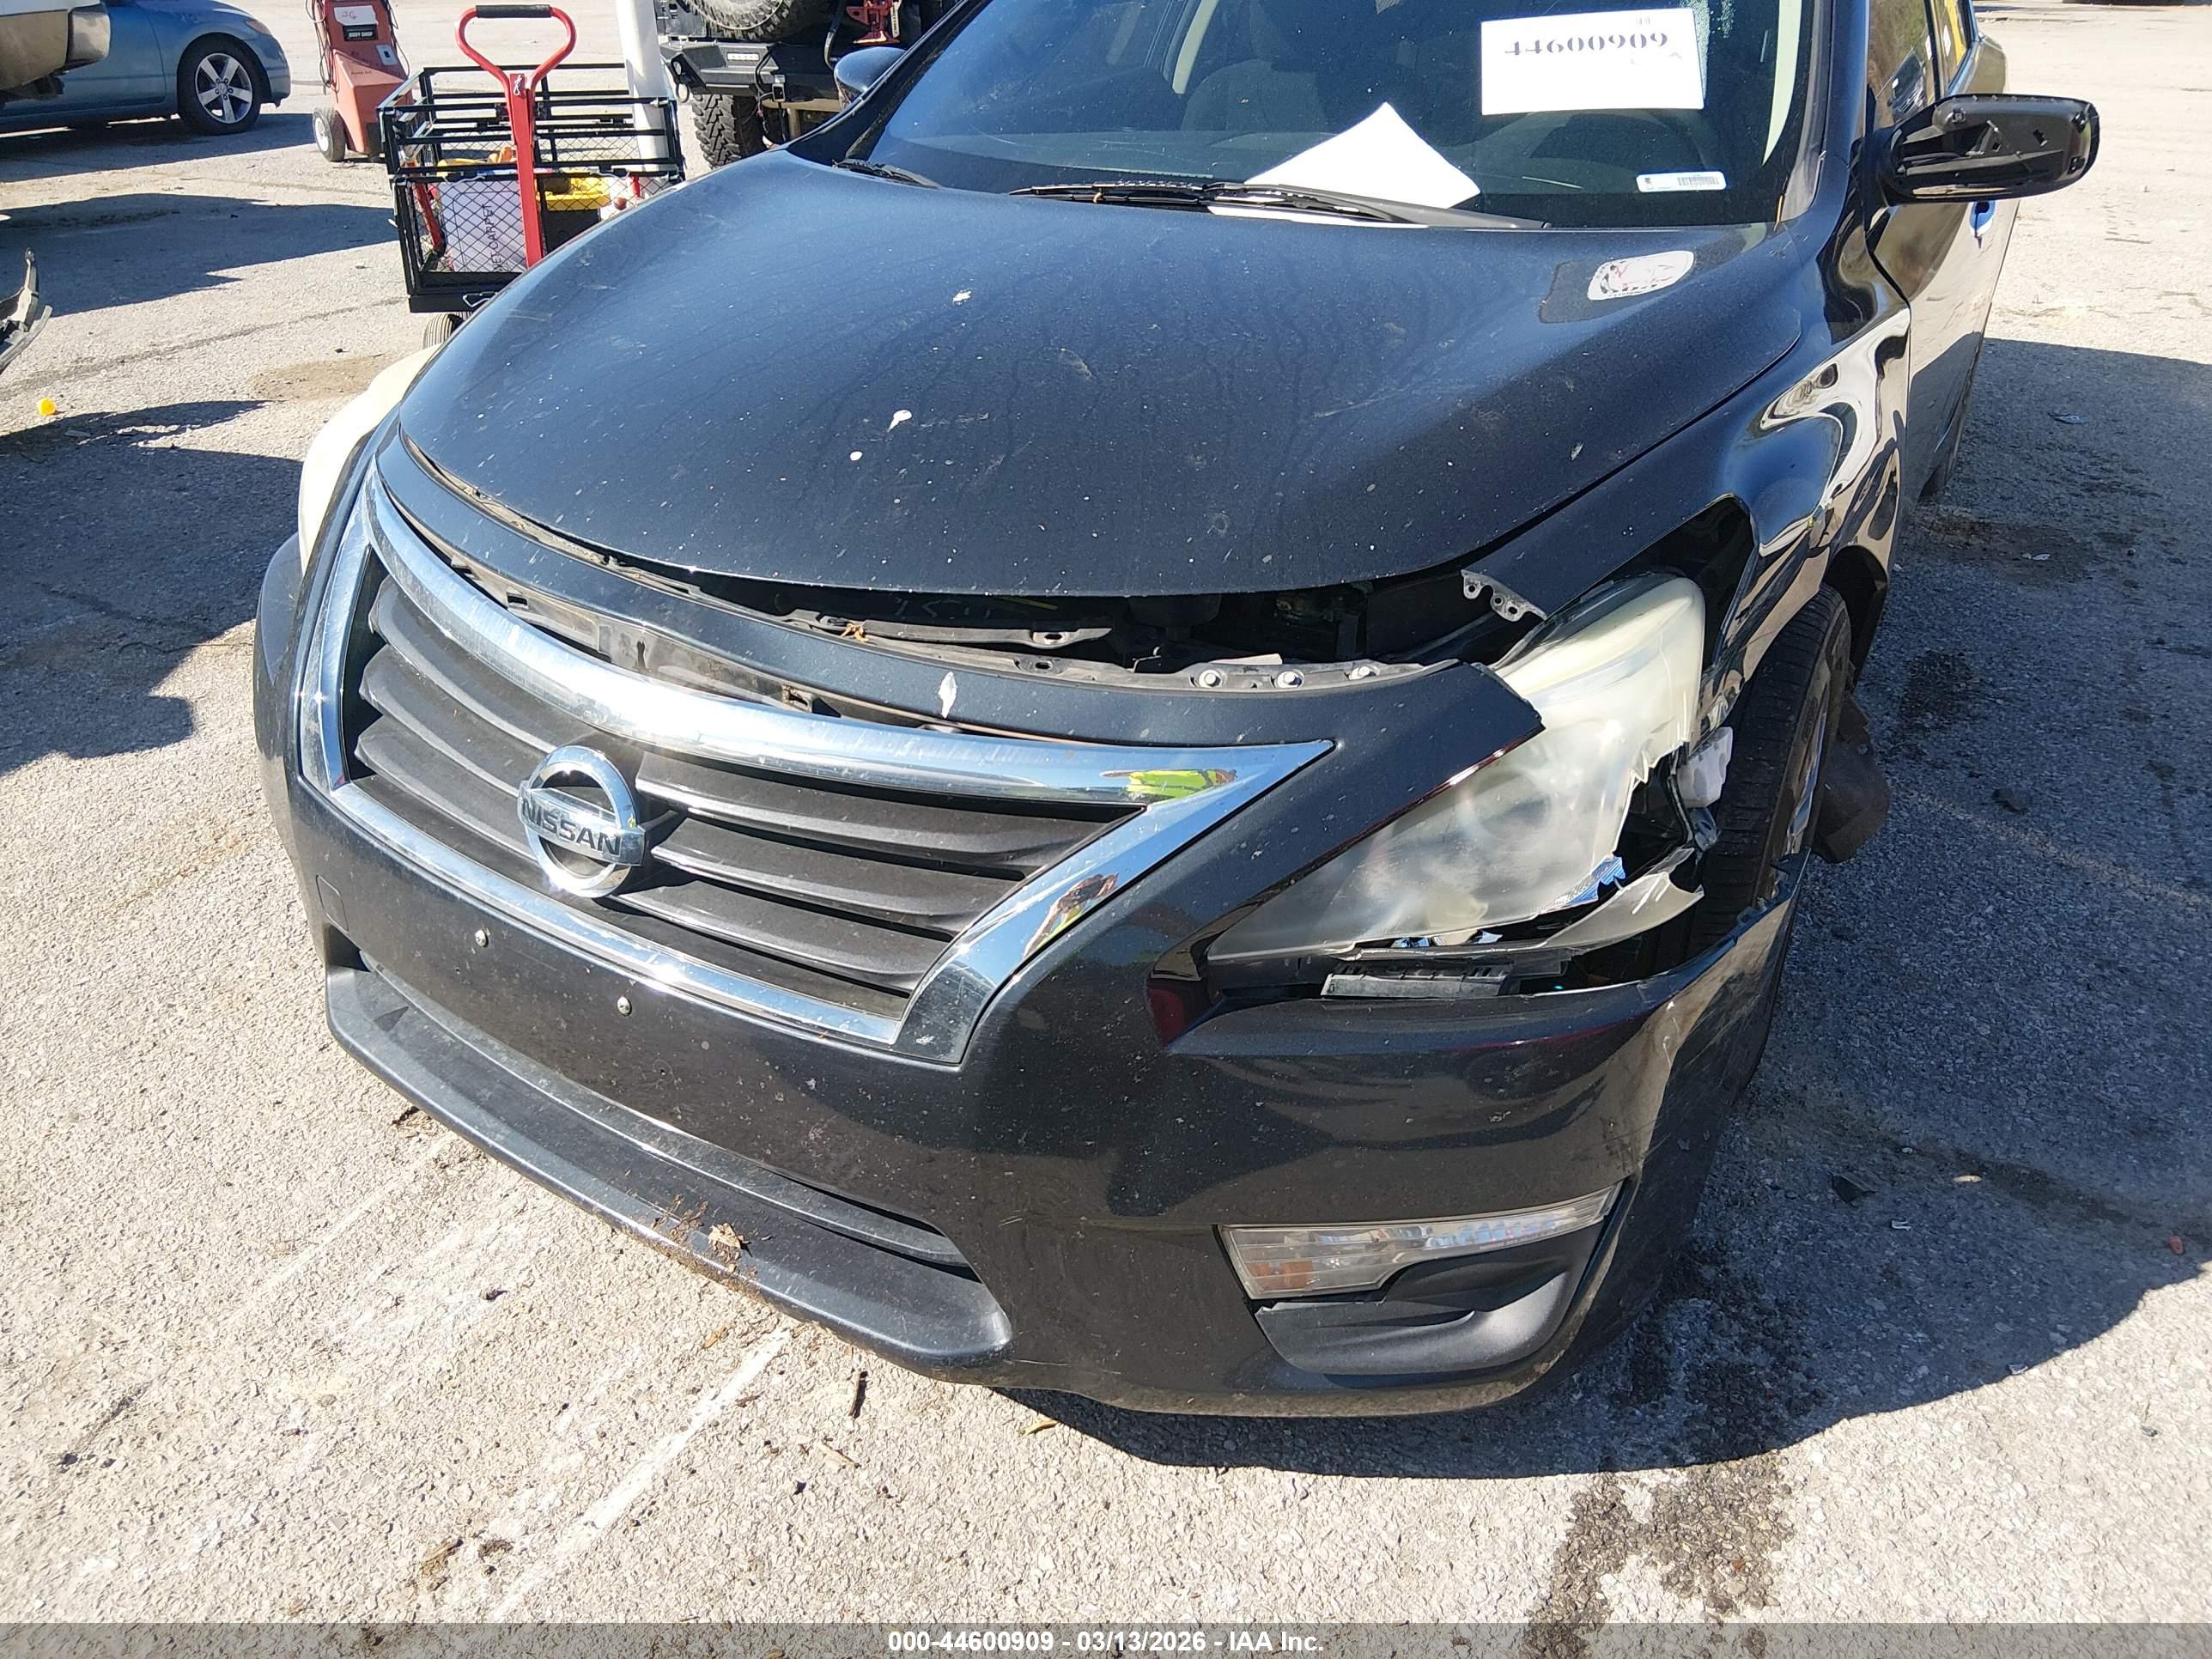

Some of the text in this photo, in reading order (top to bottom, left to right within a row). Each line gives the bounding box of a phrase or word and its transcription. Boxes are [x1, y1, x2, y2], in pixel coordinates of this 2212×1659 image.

[1504, 33, 1668, 56] 44600909
[482, 204, 499, 250] CARPET
[521, 794, 621, 856] NISSAN
